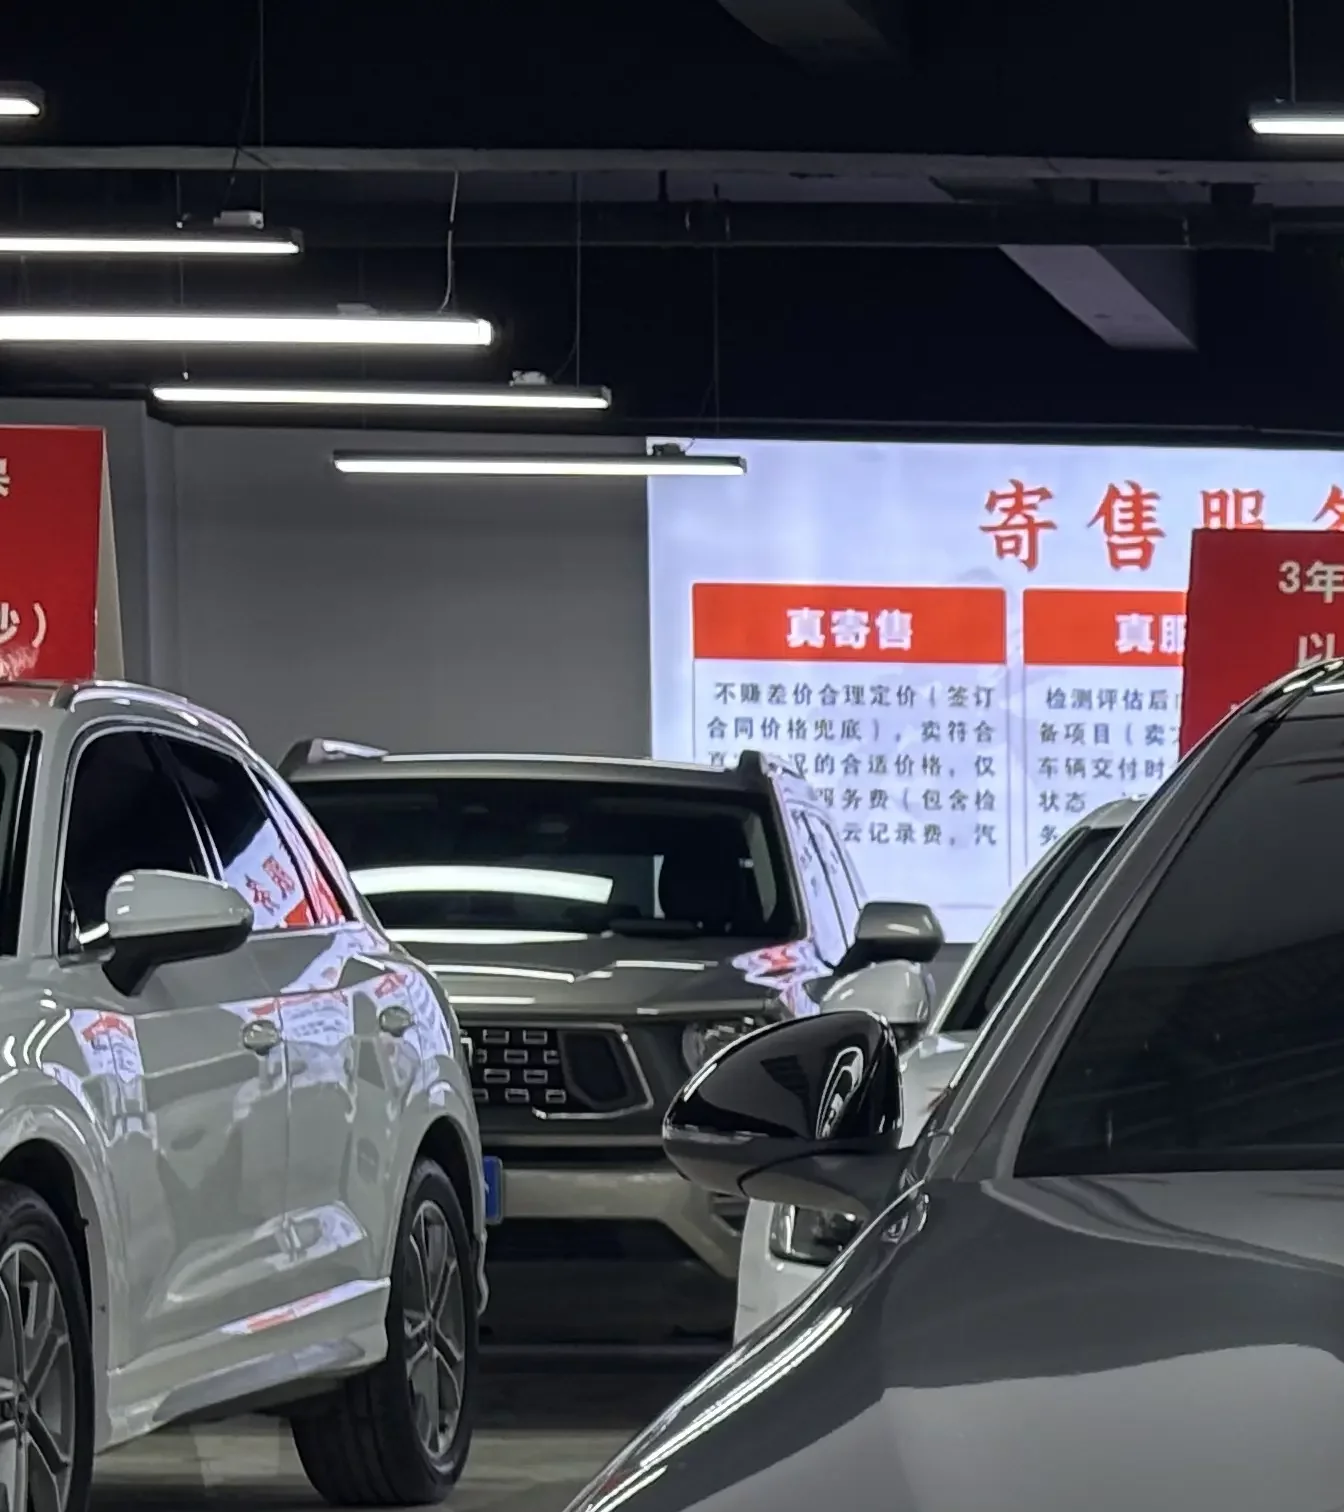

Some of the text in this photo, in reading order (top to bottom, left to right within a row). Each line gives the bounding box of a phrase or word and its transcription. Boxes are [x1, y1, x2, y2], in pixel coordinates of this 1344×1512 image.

[786, 609, 913, 650] 真寄售
[1046, 687, 1180, 711] 检测评估后
[1040, 722, 1179, 745] 备项目（卖
